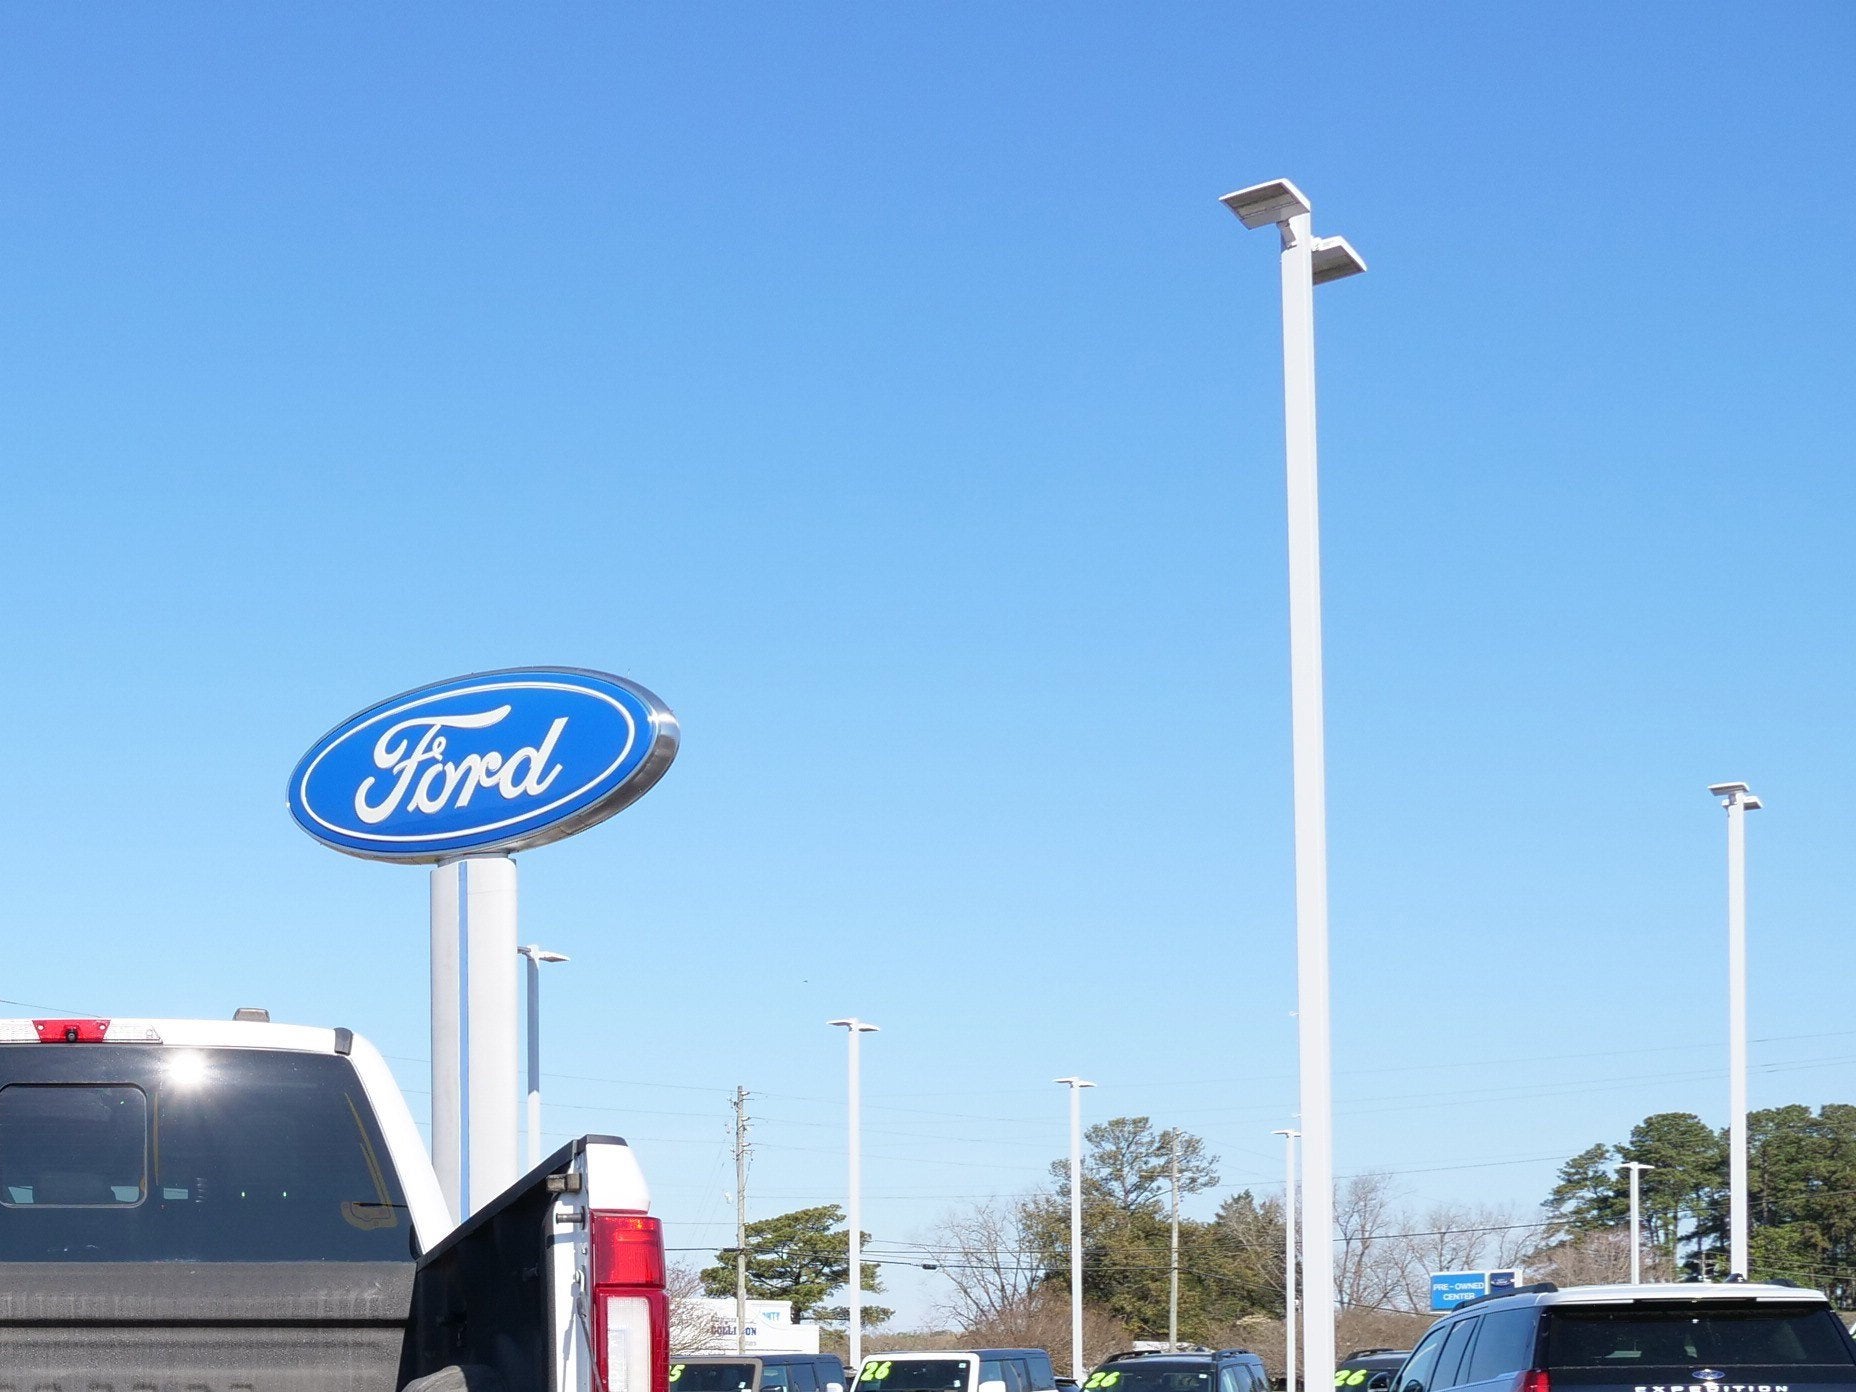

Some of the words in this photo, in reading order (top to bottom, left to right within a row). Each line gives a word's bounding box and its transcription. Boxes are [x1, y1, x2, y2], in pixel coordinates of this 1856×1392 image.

[354, 704, 569, 825] Ford
[1443, 1292, 1475, 1301] CENTER
[669, 1364, 686, 1382] 5
[860, 1361, 892, 1381] 26
[1085, 1371, 1121, 1389] 26
[1334, 1369, 1368, 1387] 26
